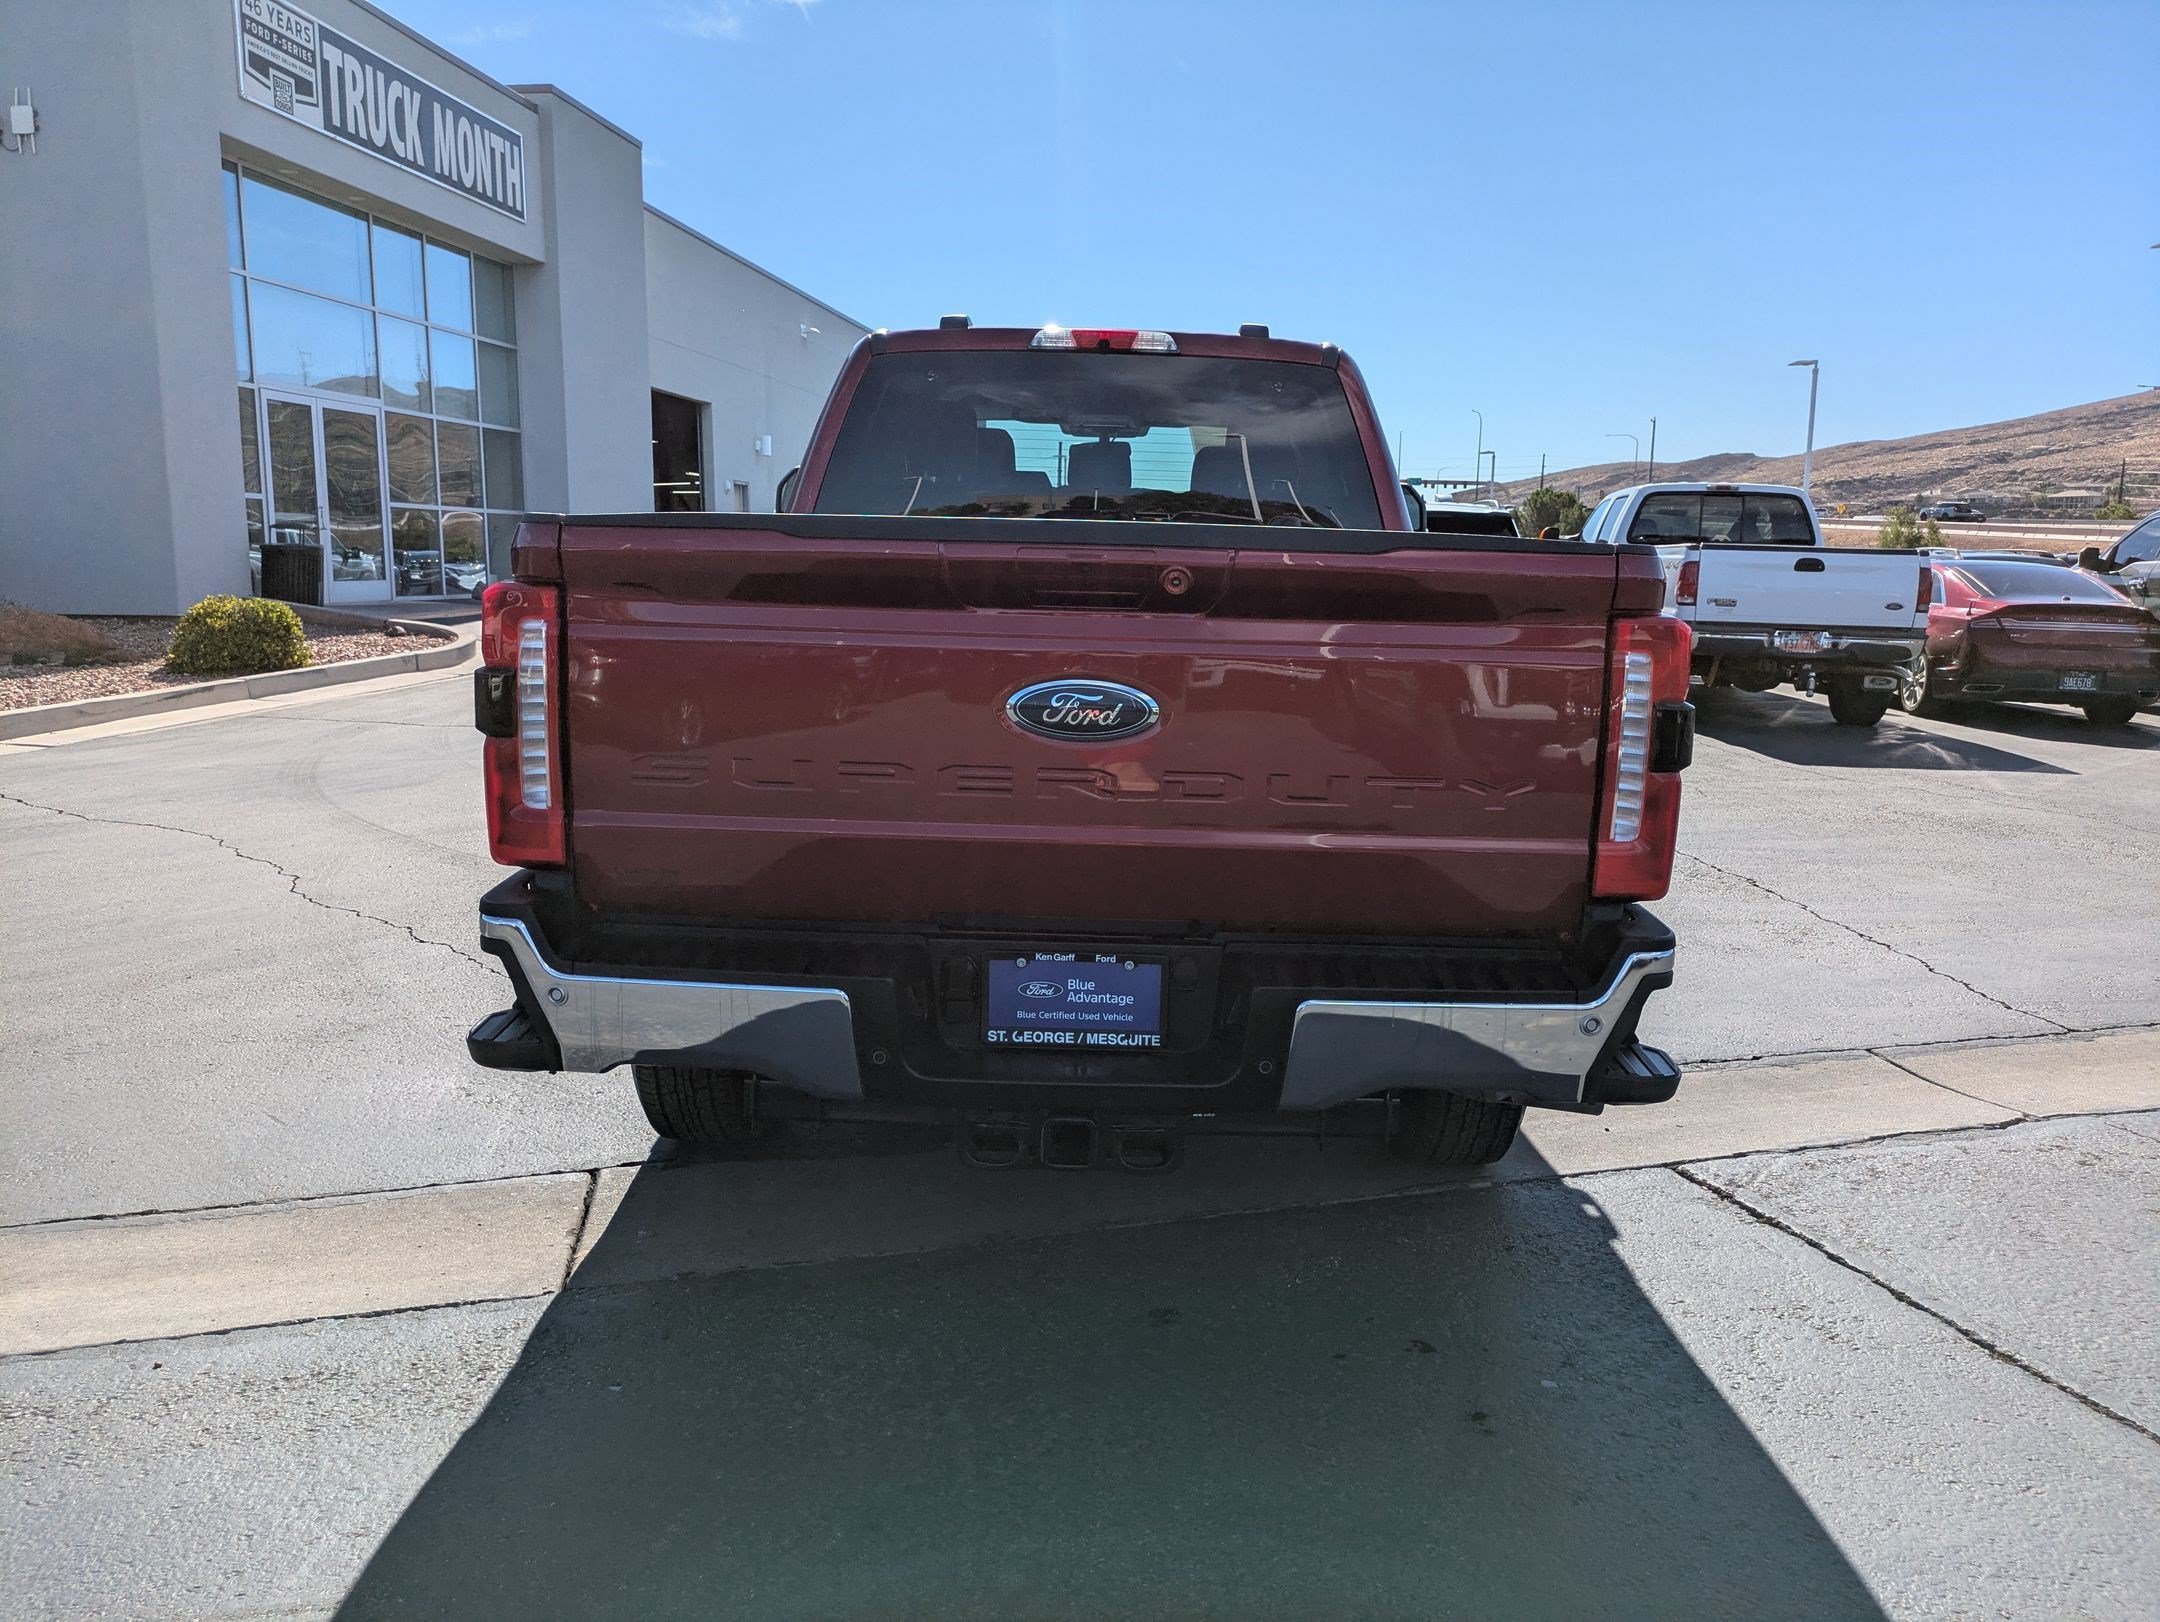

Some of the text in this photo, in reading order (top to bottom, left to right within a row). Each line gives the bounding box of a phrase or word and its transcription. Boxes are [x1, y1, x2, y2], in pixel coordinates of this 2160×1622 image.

[245, 0, 312, 44] 46 YEARS
[245, 19, 313, 63] FORD F-SERIES
[274, 78, 291, 94] BUILT
[276, 99, 292, 112] TOUGH
[322, 41, 522, 212] TRUCK MONTH
[2064, 677, 2092, 688] 9AE678
[1042, 692, 1123, 726] Ford
[631, 753, 1537, 811] SUPER DUTY
[1035, 953, 1116, 963] Ken Garff Ford
[1026, 983, 1054, 996] Ford
[1067, 979, 1095, 990] Blue
[1067, 992, 1134, 1006] Advantage
[1017, 1010, 1134, 1022] Blue Certified Used Vehicle
[988, 1030, 1007, 1042] ST.
[1012, 1031, 1074, 1043] GEORGE
[1087, 1033, 1161, 1046] MESQUITE
